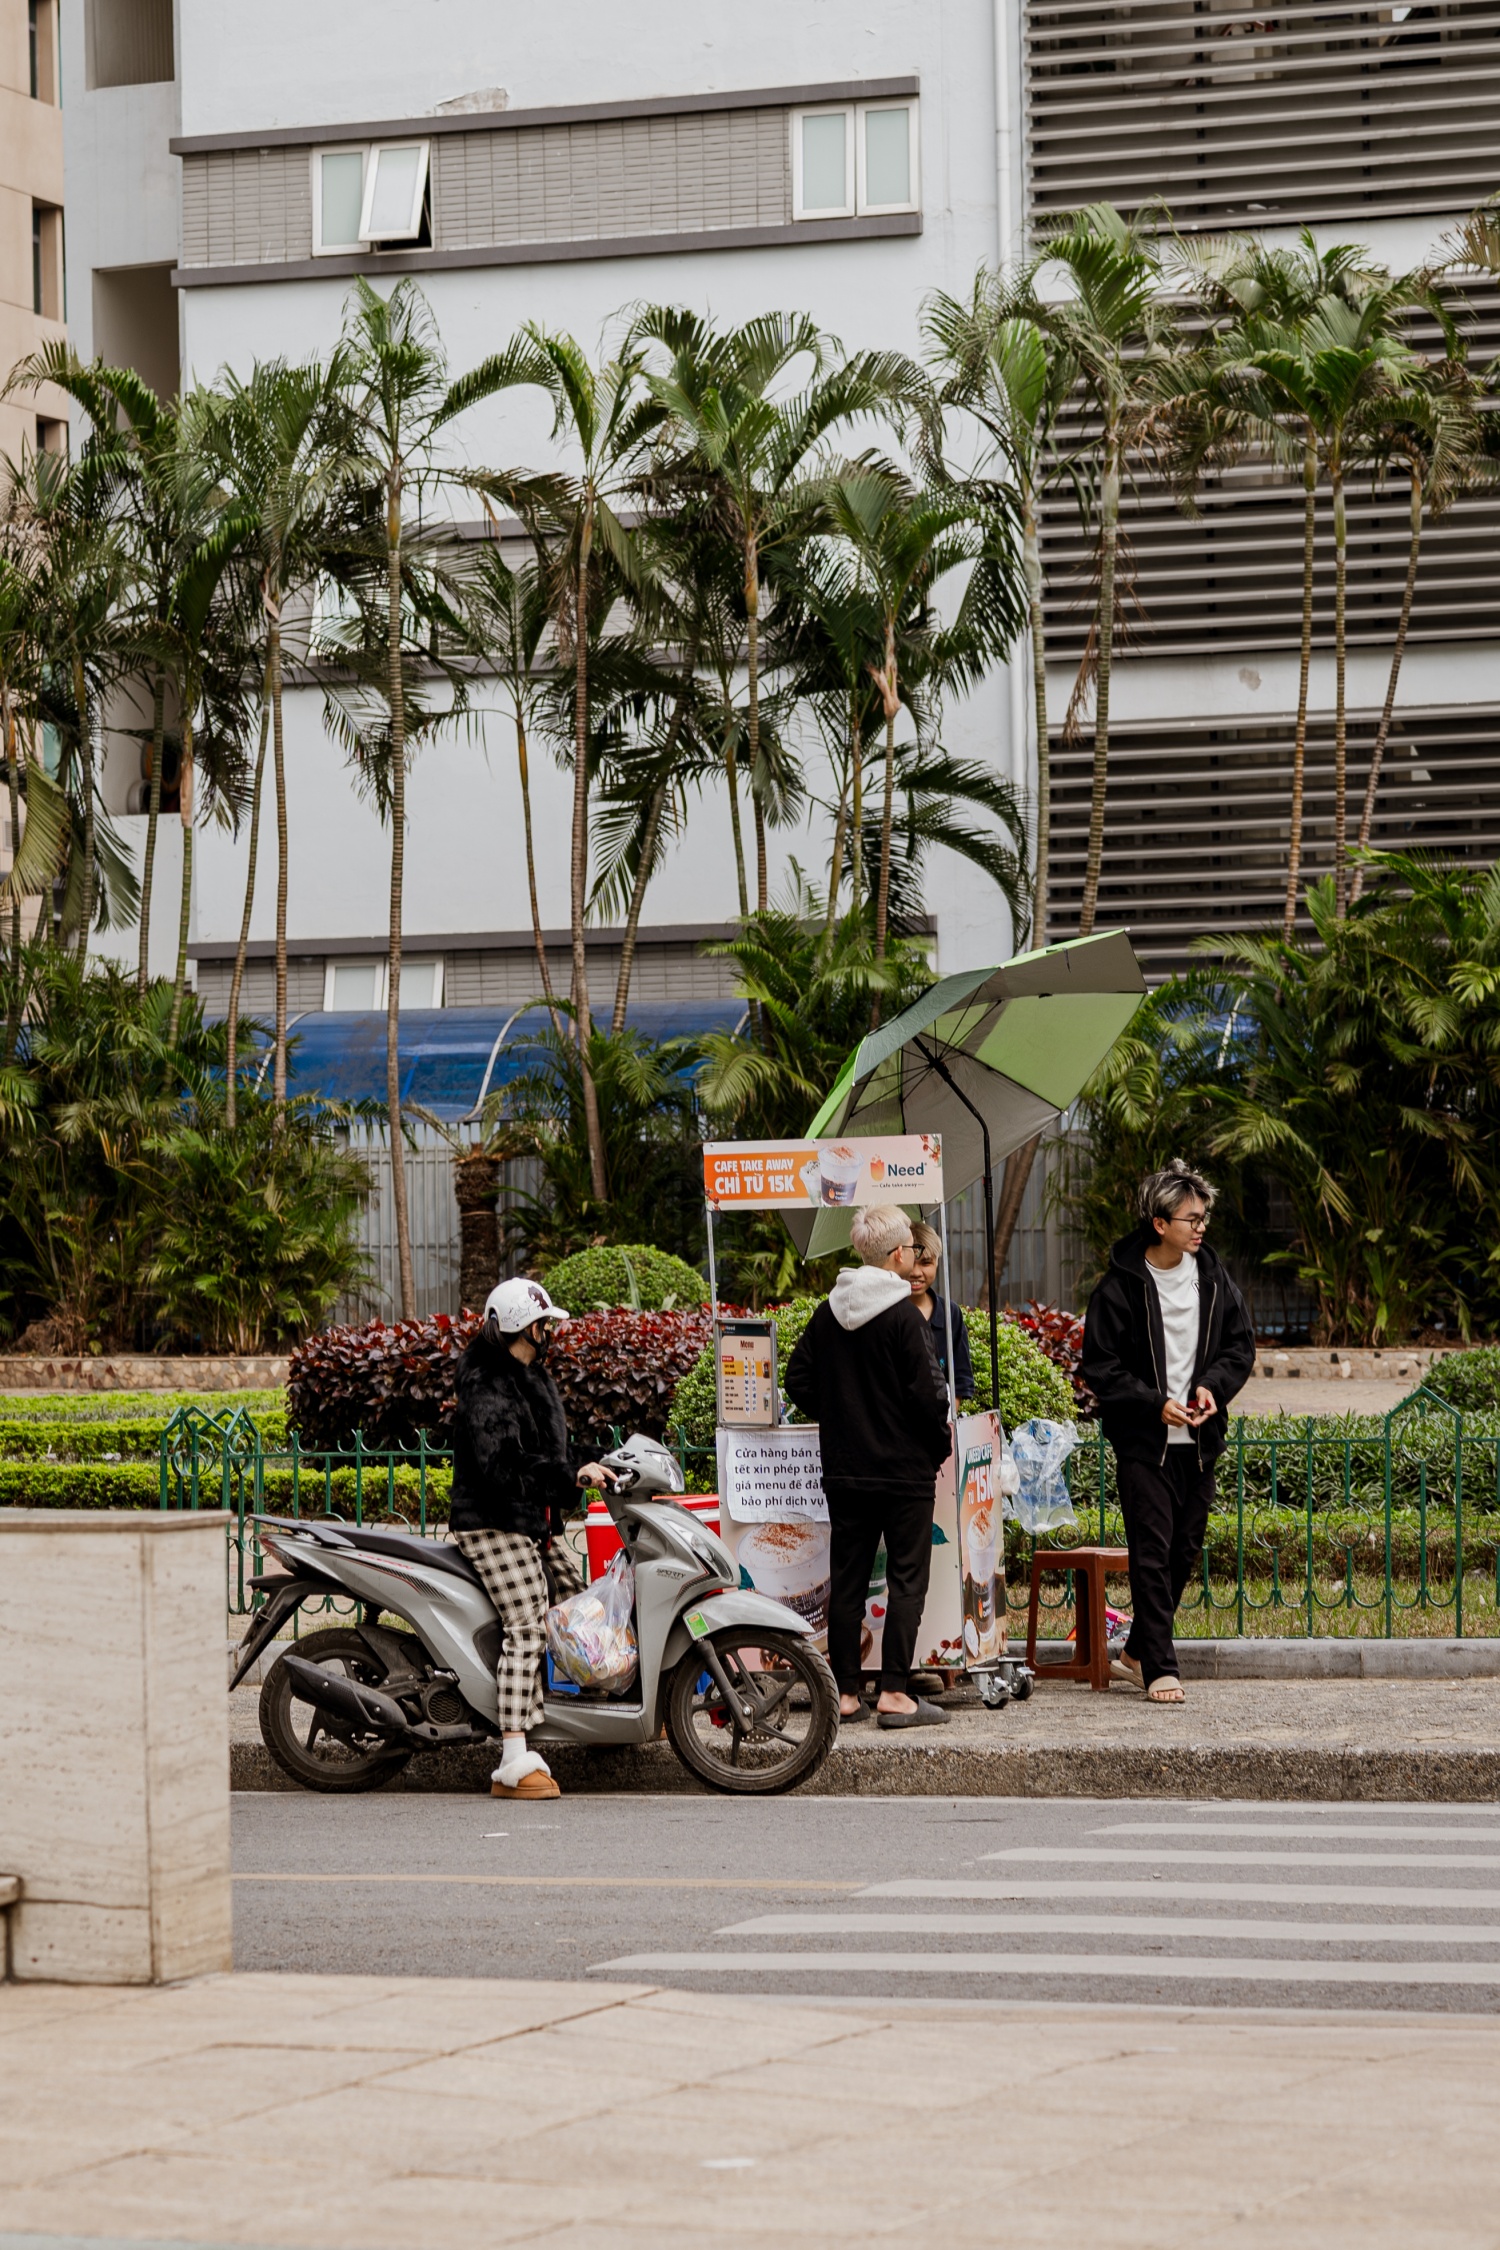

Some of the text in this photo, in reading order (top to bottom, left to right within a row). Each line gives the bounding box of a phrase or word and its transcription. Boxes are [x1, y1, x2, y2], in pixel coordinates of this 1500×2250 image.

[714, 1158, 794, 1173] CAFE TAKE AWAY
[888, 1161, 924, 1177] Need
[715, 1172, 795, 1194] CHỈ TỪ 15K
[740, 1340, 754, 1349] Menu
[735, 1447, 757, 1458] Cửa
[760, 1448, 788, 1460] hàng
[791, 1448, 812, 1458] bán
[735, 1464, 822, 1476] tết xin phép tăn
[735, 1479, 822, 1492] giá menu để đả
[974, 1464, 994, 1503] 15K
[741, 1496, 824, 1508] bảo phí dịch vụ
